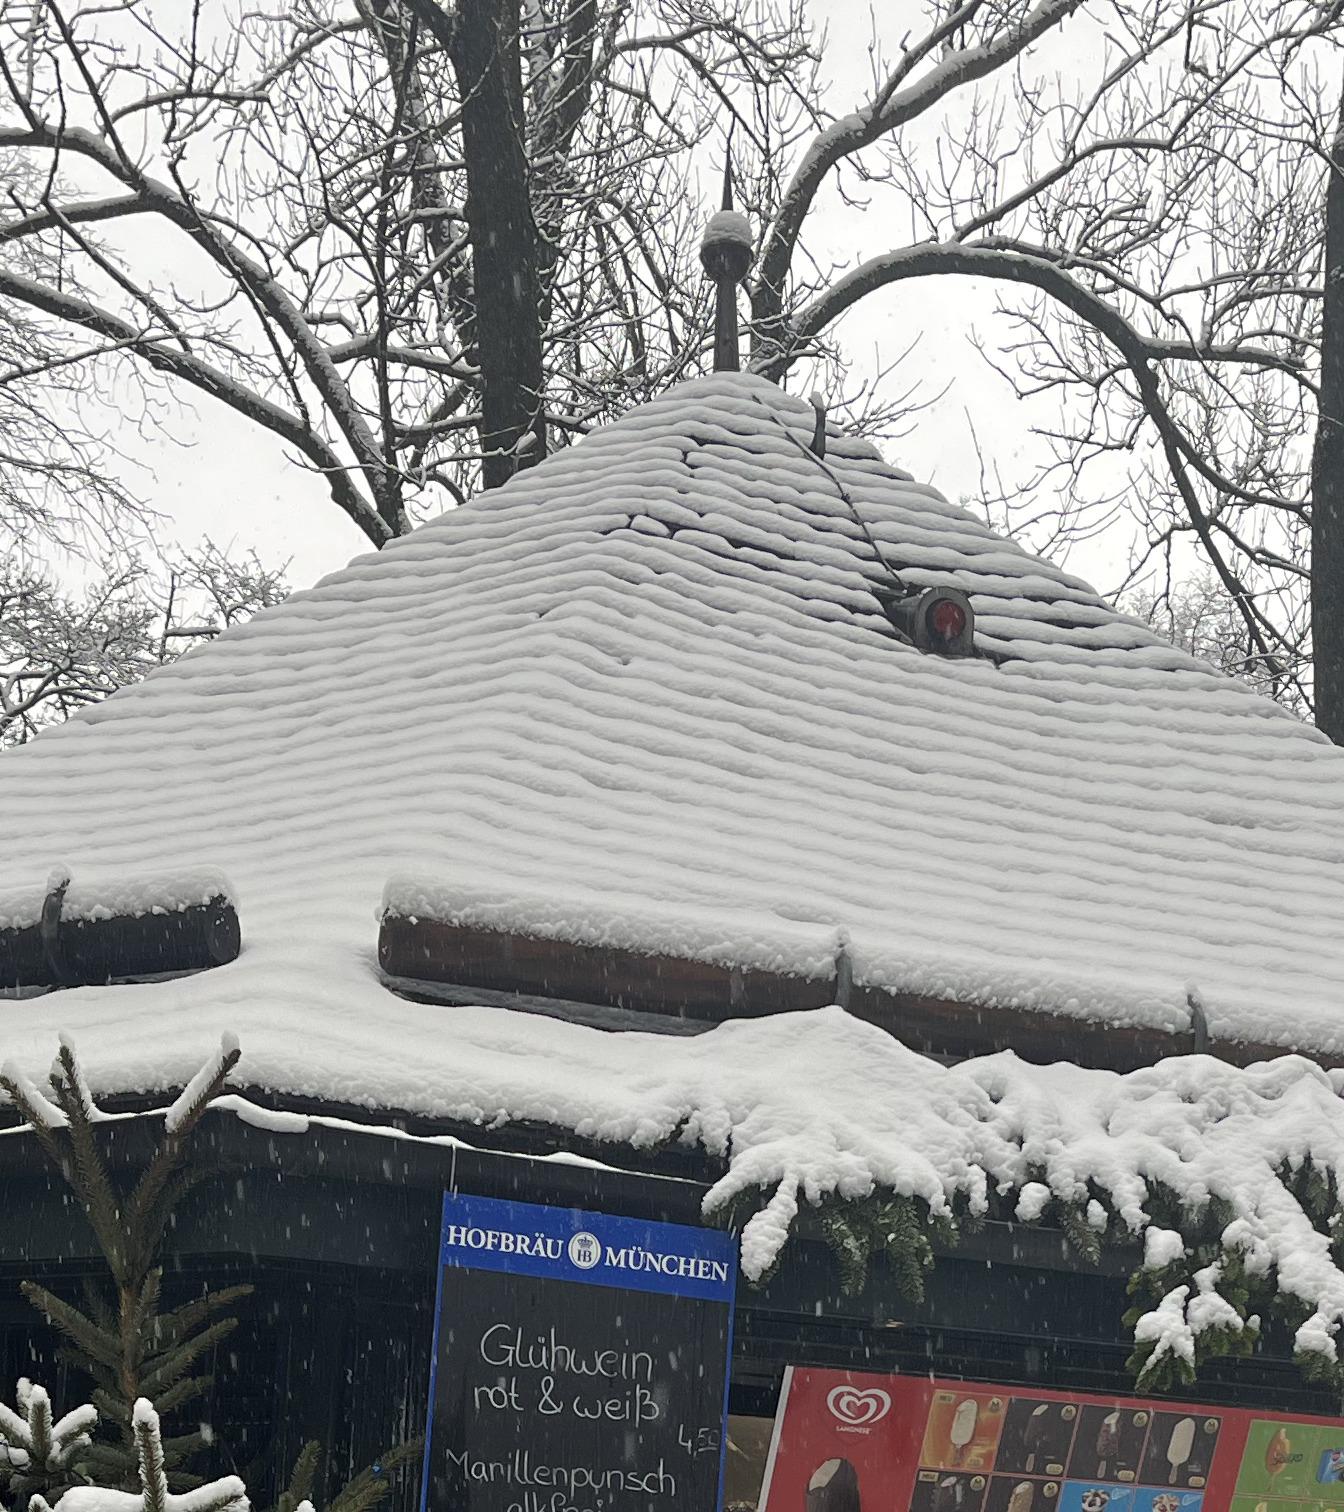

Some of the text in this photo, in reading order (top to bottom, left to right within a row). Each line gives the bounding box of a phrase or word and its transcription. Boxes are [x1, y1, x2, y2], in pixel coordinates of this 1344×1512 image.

[446, 1224, 564, 1259] HOFBRÄU
[604, 1245, 729, 1283] MÜNCHEN
[481, 1323, 653, 1383] Glühwein
[474, 1375, 660, 1429] rot & weiß
